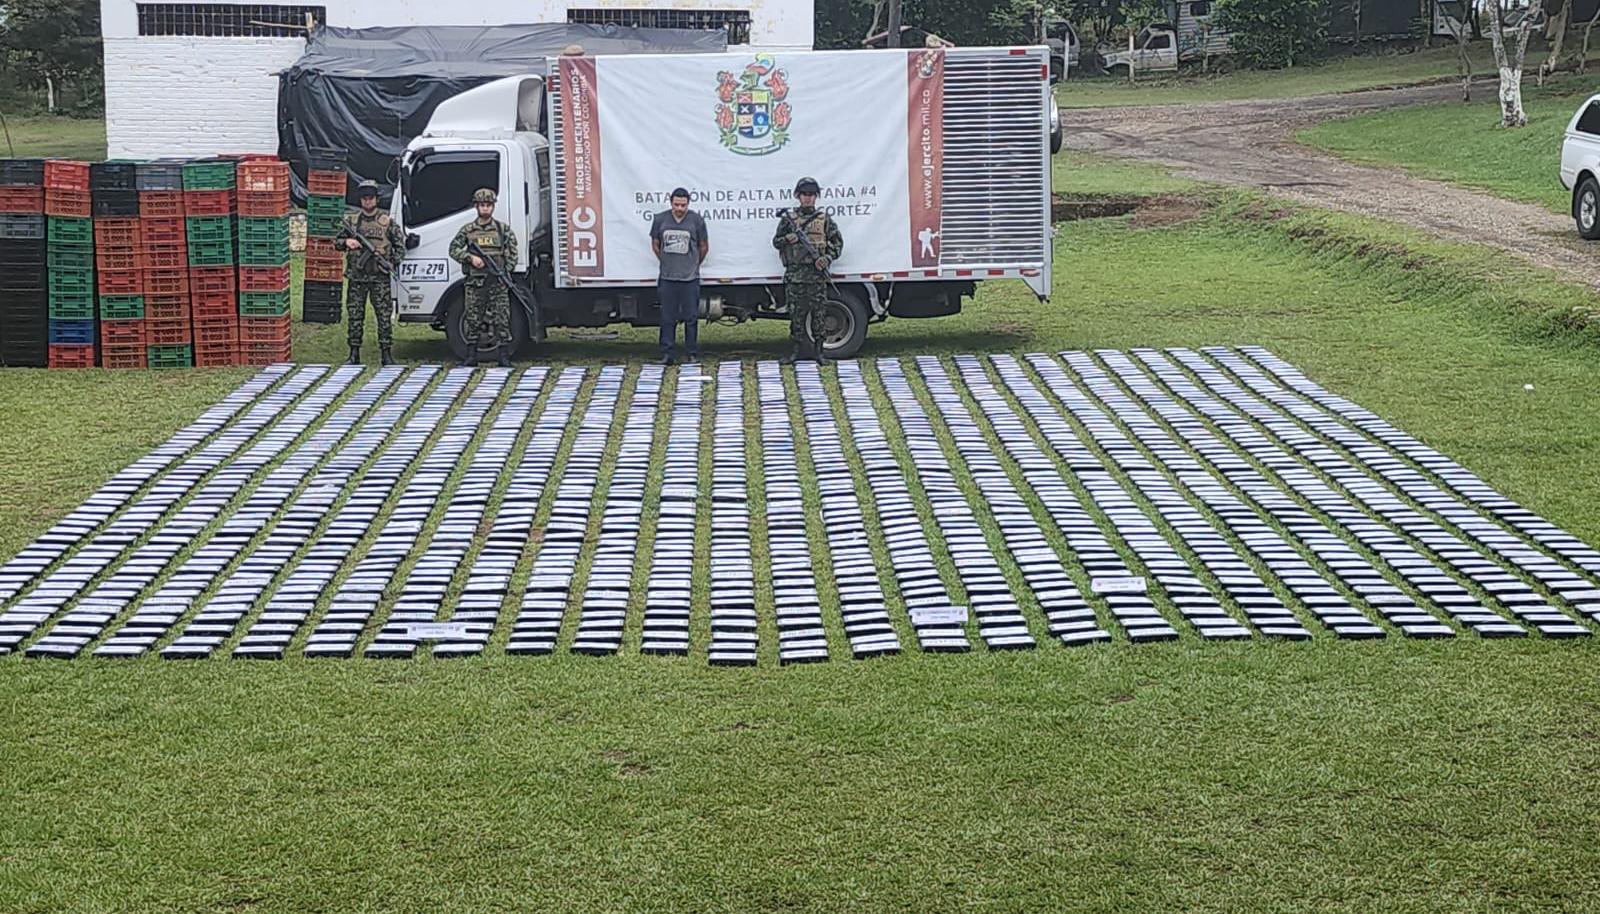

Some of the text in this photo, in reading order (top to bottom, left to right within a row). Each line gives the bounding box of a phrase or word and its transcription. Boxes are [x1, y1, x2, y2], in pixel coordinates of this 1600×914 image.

[582, 121, 591, 139] POR
[921, 89, 935, 209] www.ejercito.mil.co
[574, 156, 584, 199] HÉROES
[635, 188, 710, 203] BATAÓN
[716, 190, 734, 202] DE
[738, 189, 774, 201] ALTA
[861, 185, 876, 197] #4
[572, 206, 598, 267] EJC
[401, 263, 445, 275] TST 279
